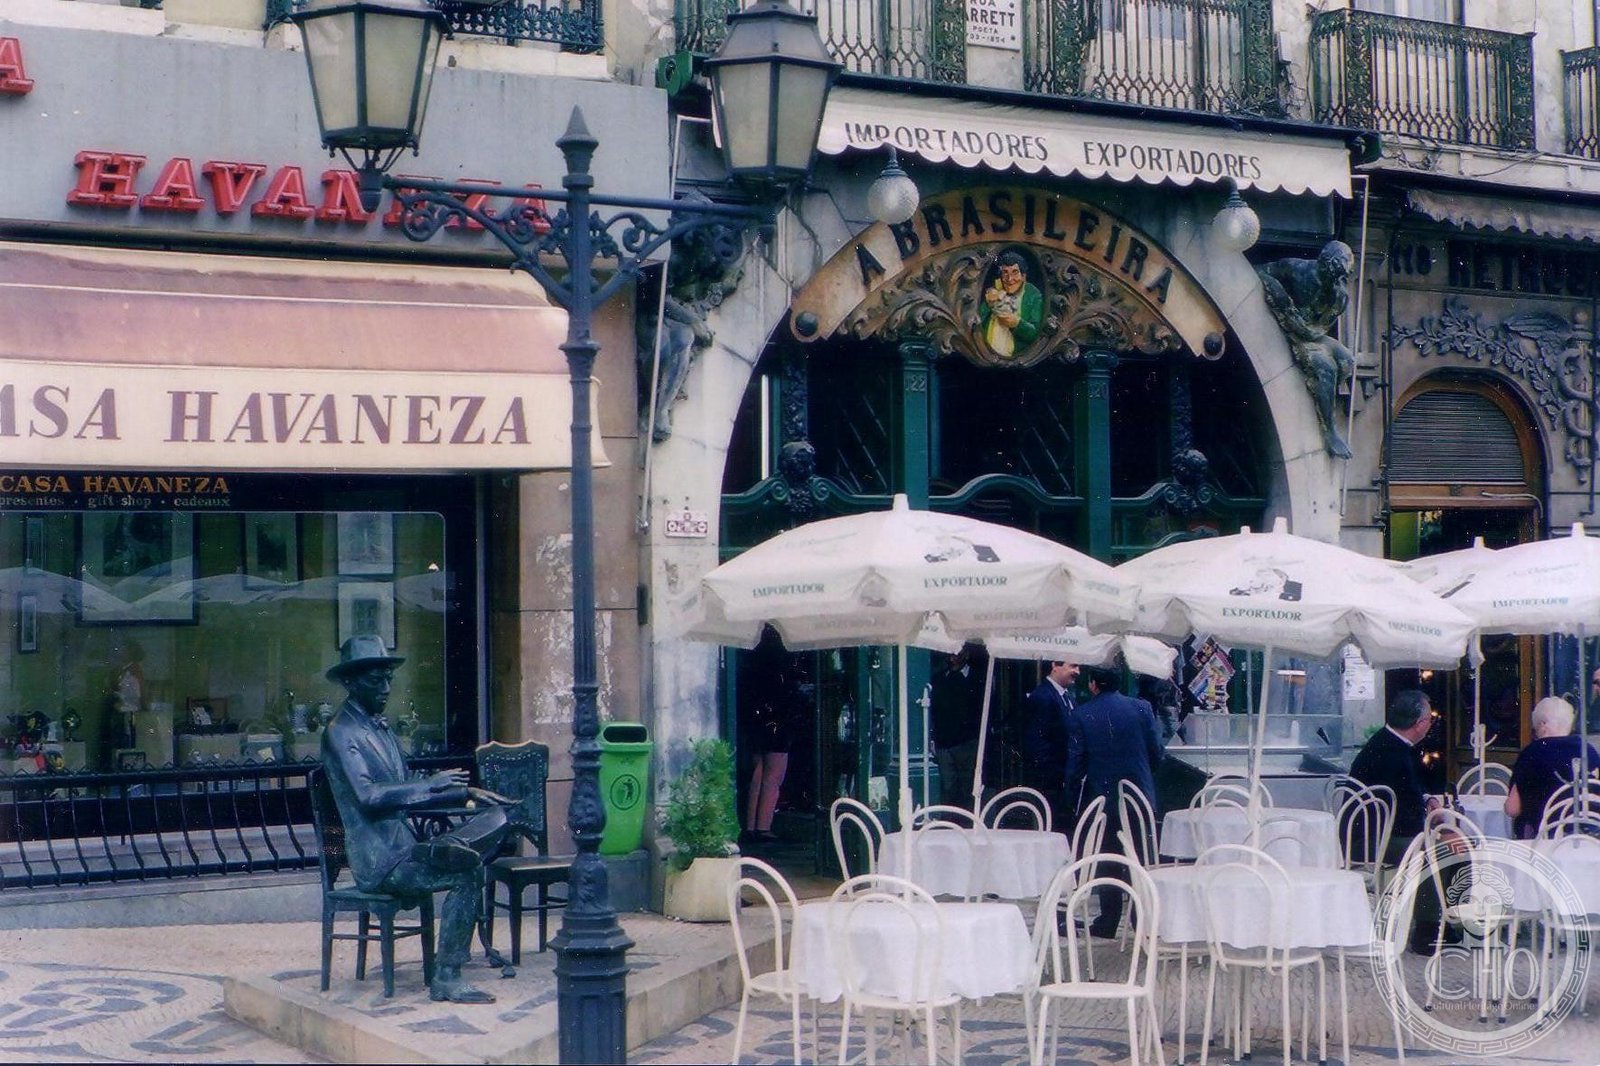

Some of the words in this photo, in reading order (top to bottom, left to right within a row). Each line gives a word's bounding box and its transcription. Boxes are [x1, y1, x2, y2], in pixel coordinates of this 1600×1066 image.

[844, 122, 1049, 161] IMPORTADORES
[1083, 141, 1262, 180] EXPORTADORES
[854, 242, 886, 289] A
[888, 189, 1174, 304] BRASILEIRA
[163, 390, 531, 445] HAVANEZA
[0, 475, 71, 493] CASA
[83, 476, 232, 495] HAVANEZA
[121, 494, 151, 508] shop
[753, 583, 825, 598] IMPORTADOR
[924, 576, 1007, 589] EXPORTADOR
[1222, 607, 1302, 622] EXPORTADOR
